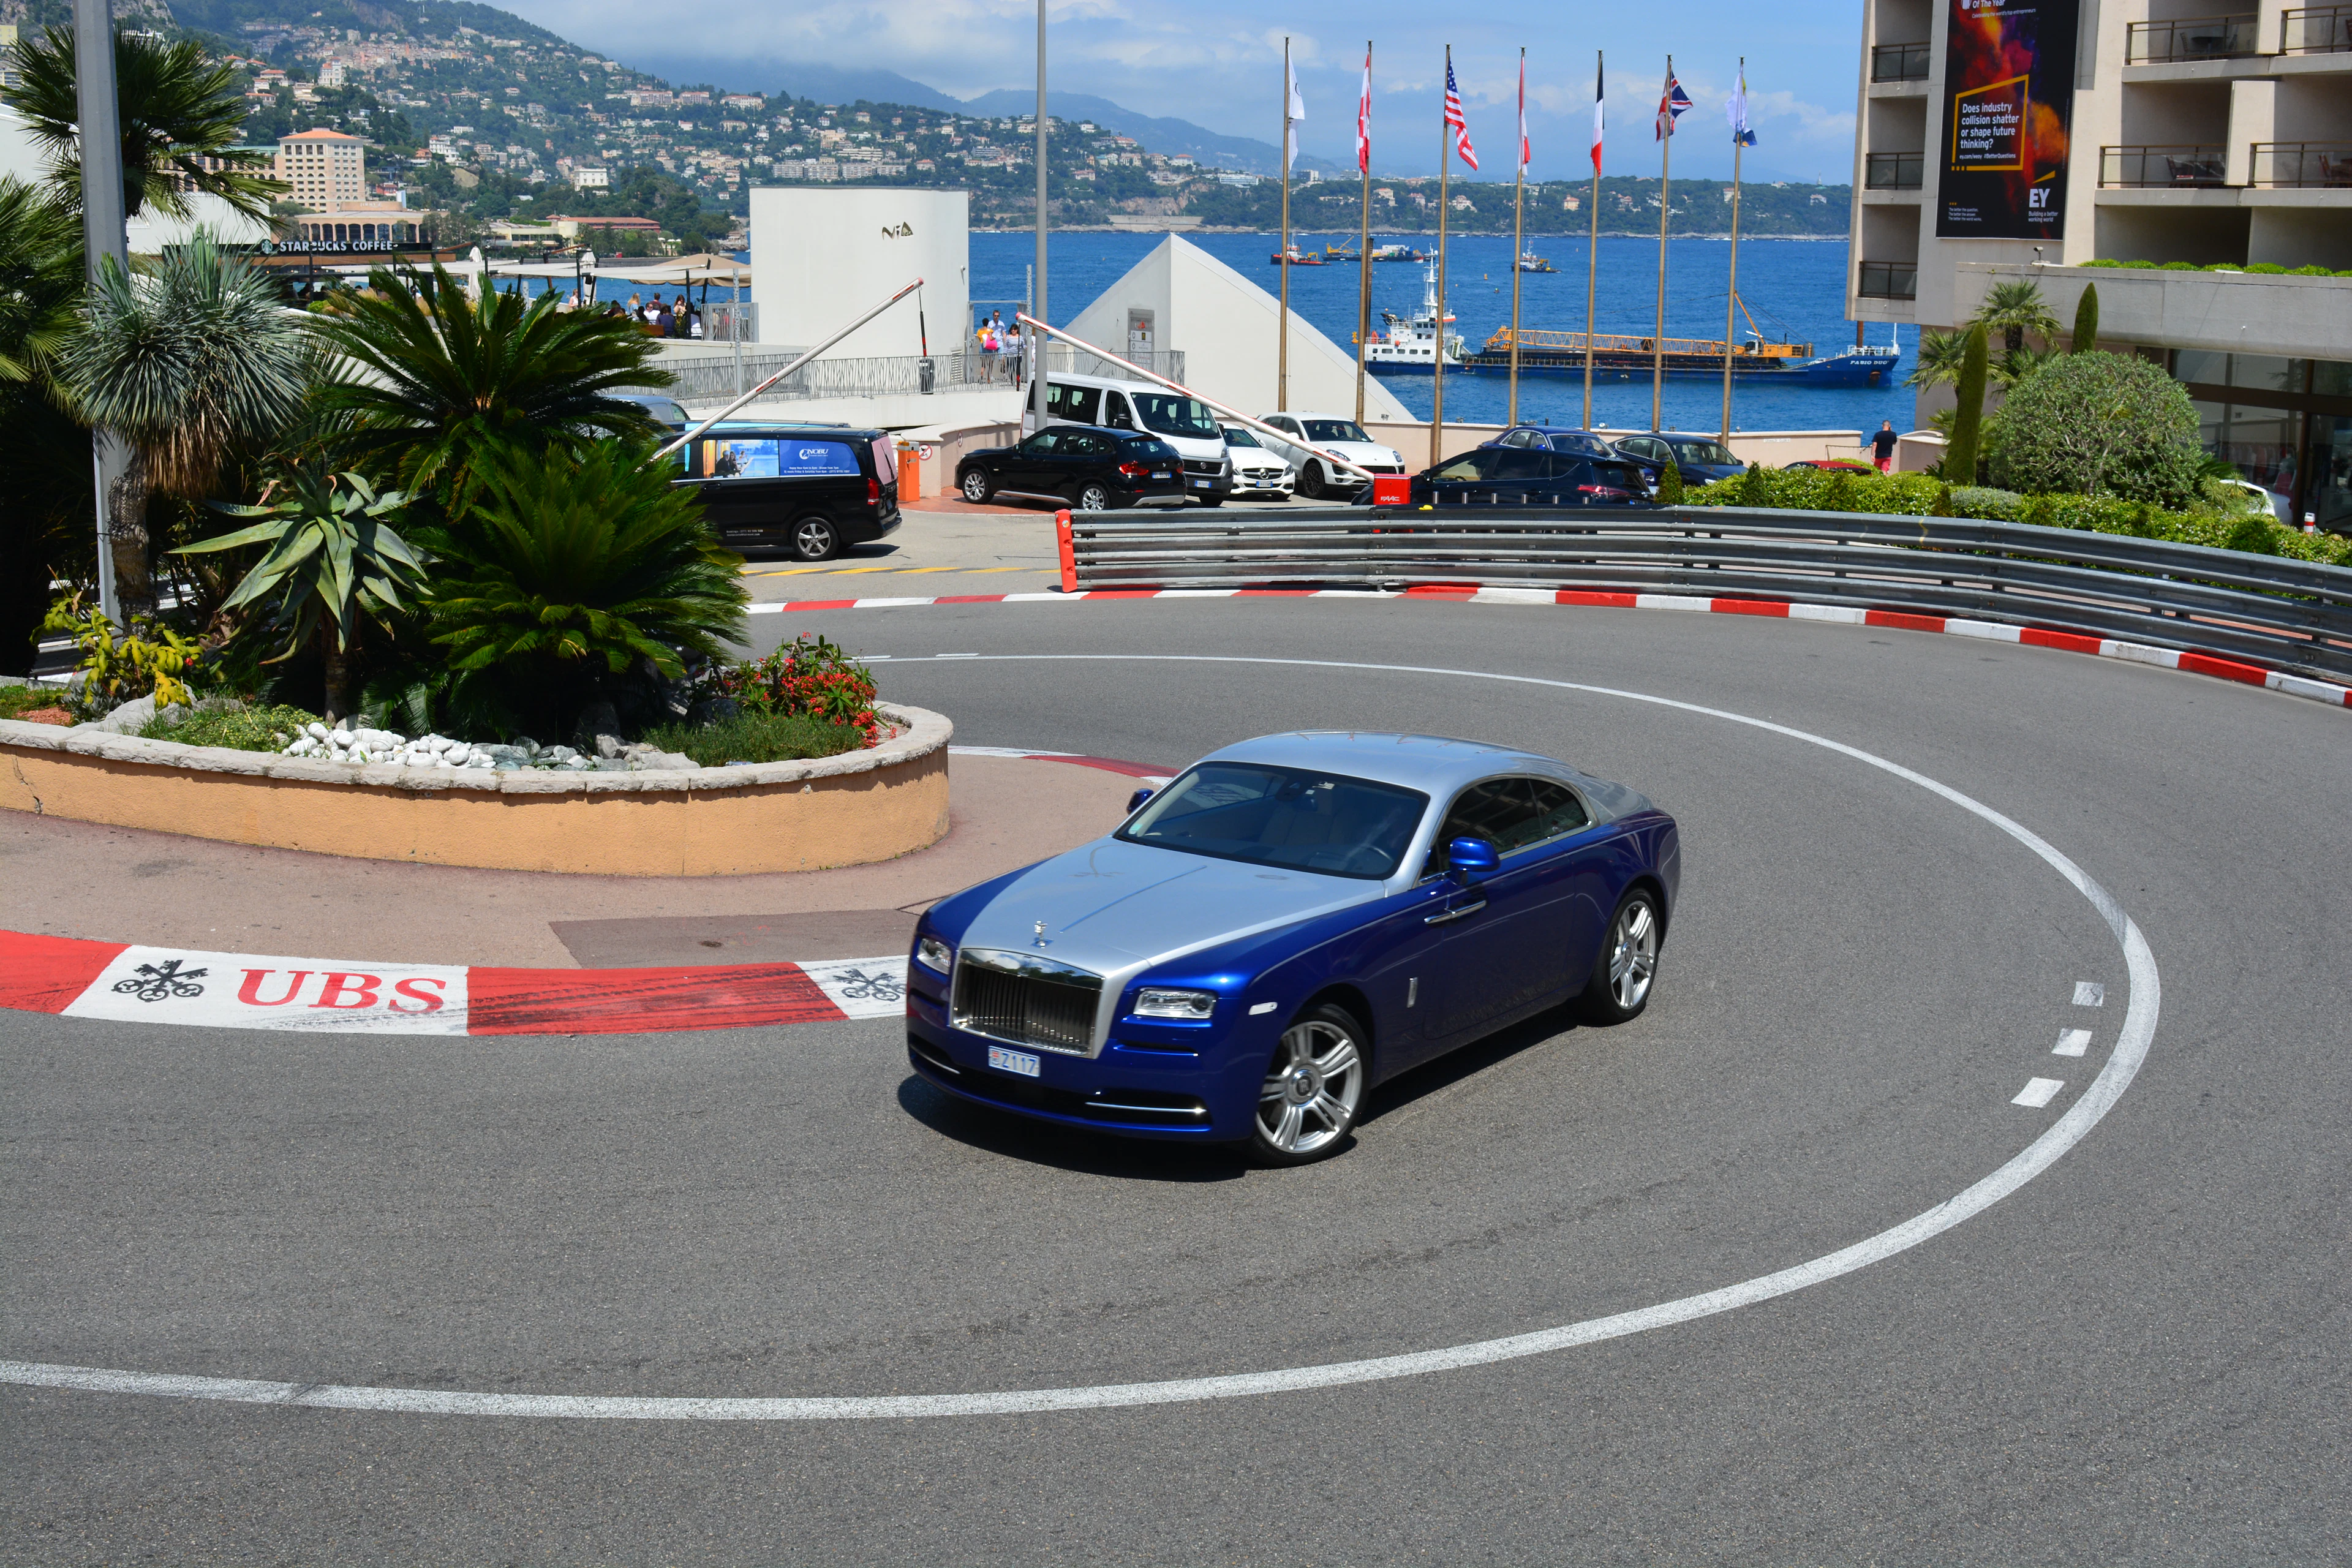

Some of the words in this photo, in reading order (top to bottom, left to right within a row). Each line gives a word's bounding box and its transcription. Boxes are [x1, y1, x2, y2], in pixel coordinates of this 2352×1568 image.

[1962, 104, 1980, 113] Does
[1981, 102, 2012, 113] industry
[1961, 115, 1990, 125] collision
[1992, 114, 2019, 124] shatter
[1970, 127, 1991, 138] shape
[1992, 126, 2016, 136] future
[1960, 138, 1994, 150] thinking?
[2029, 188, 2050, 208] EY
[352, 240, 393, 251] COFFEE
[238, 968, 447, 1014] UBS
